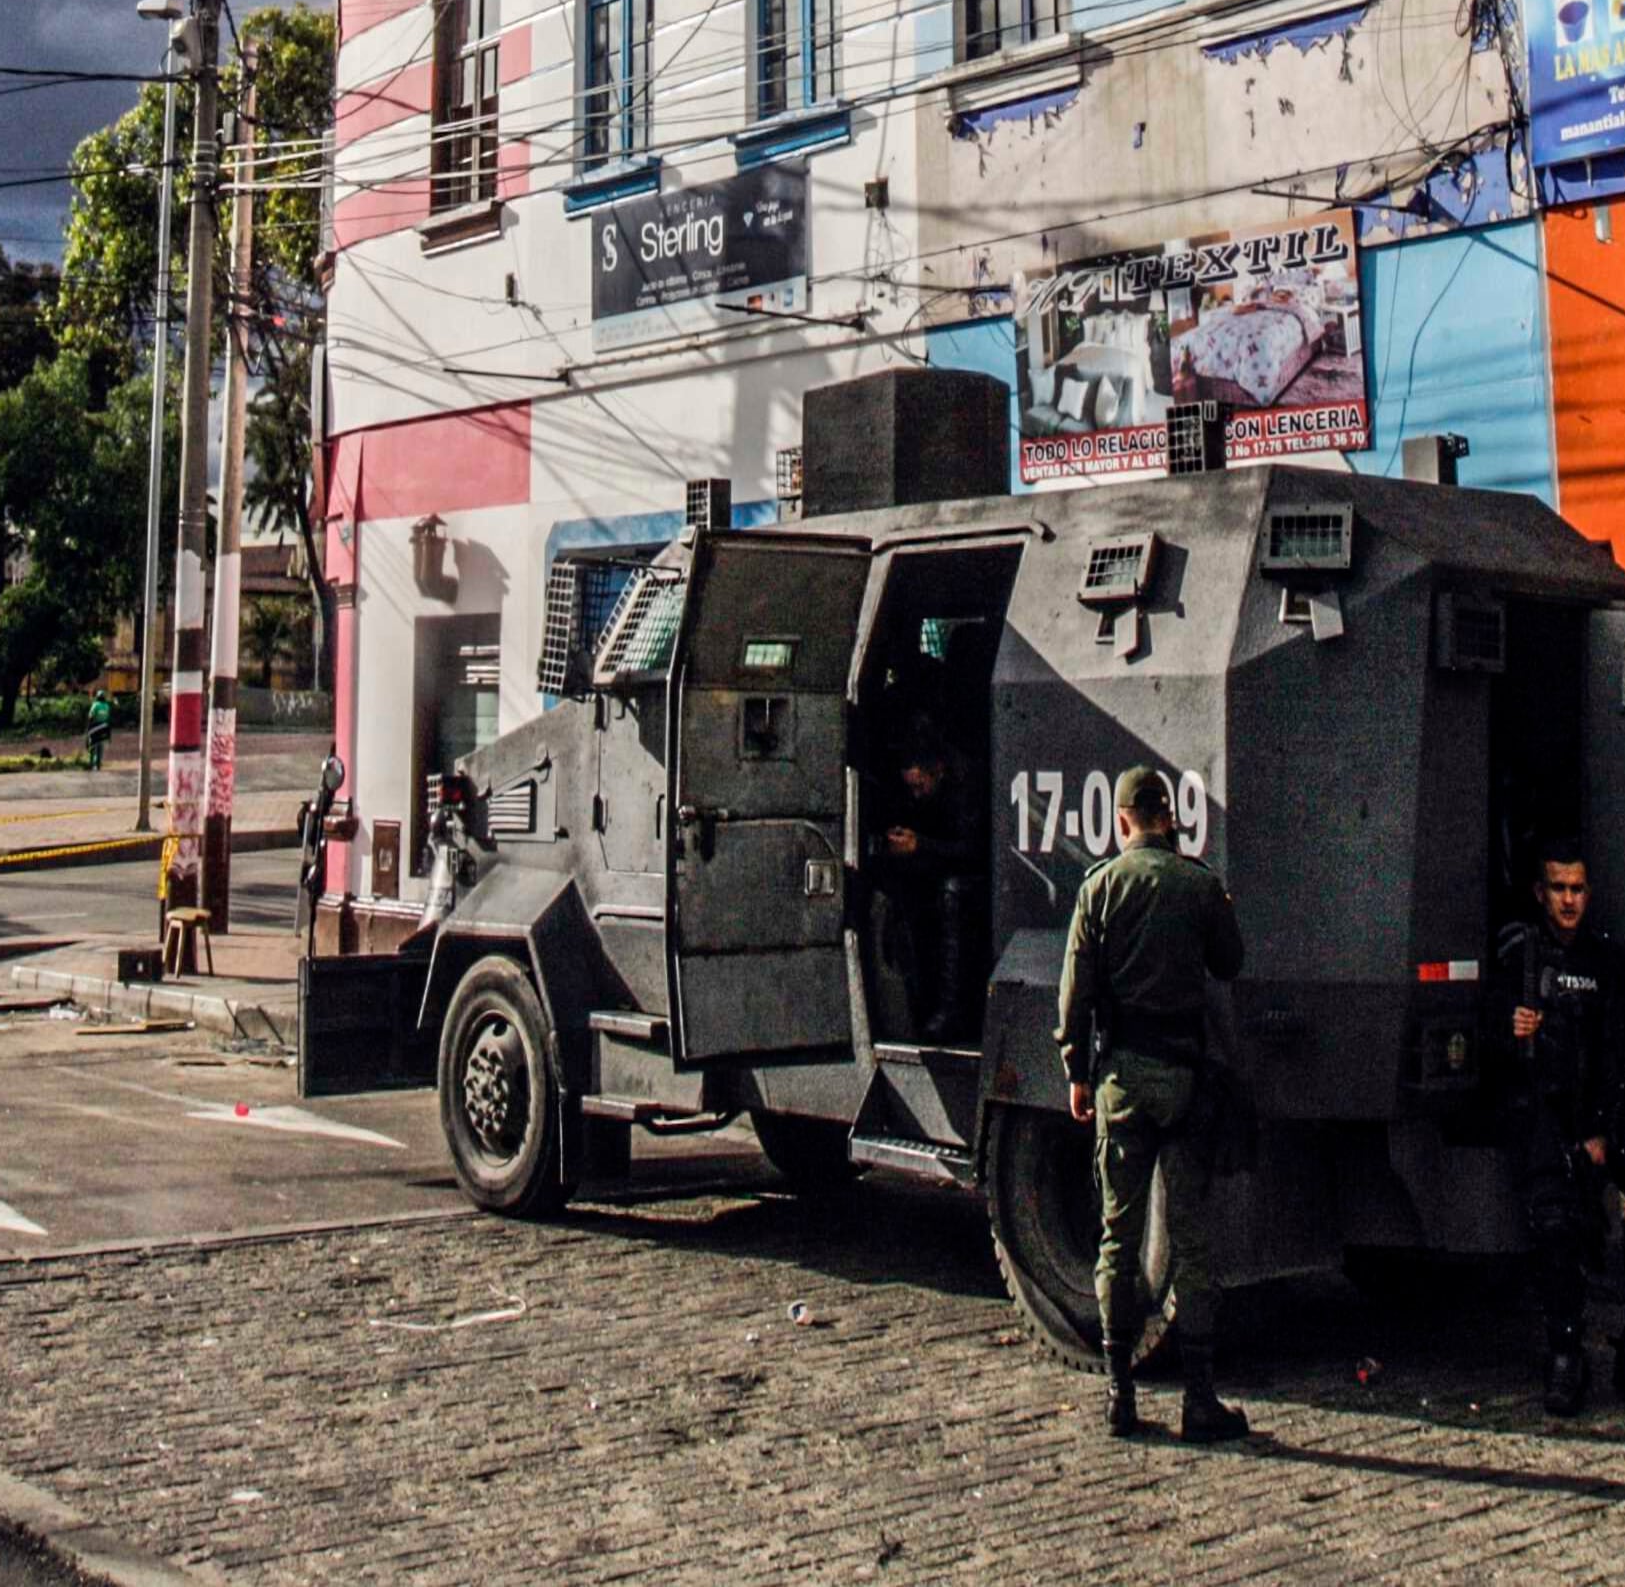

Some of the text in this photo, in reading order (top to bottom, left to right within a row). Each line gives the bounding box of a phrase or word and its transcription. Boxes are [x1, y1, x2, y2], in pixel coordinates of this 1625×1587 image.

[1554, 54, 1576, 81] LA
[640, 212, 724, 262] Sterling
[1126, 223, 1349, 296] TEXTIL
[1266, 406, 1362, 437] LENCERIA
[1072, 438, 1092, 458] LO
[1351, 430, 1365, 444] 70
[1024, 464, 1060, 480] VENTAS
[1086, 457, 1119, 474] MAYOR
[1123, 456, 1130, 469] Y
[1132, 455, 1145, 468] AL
